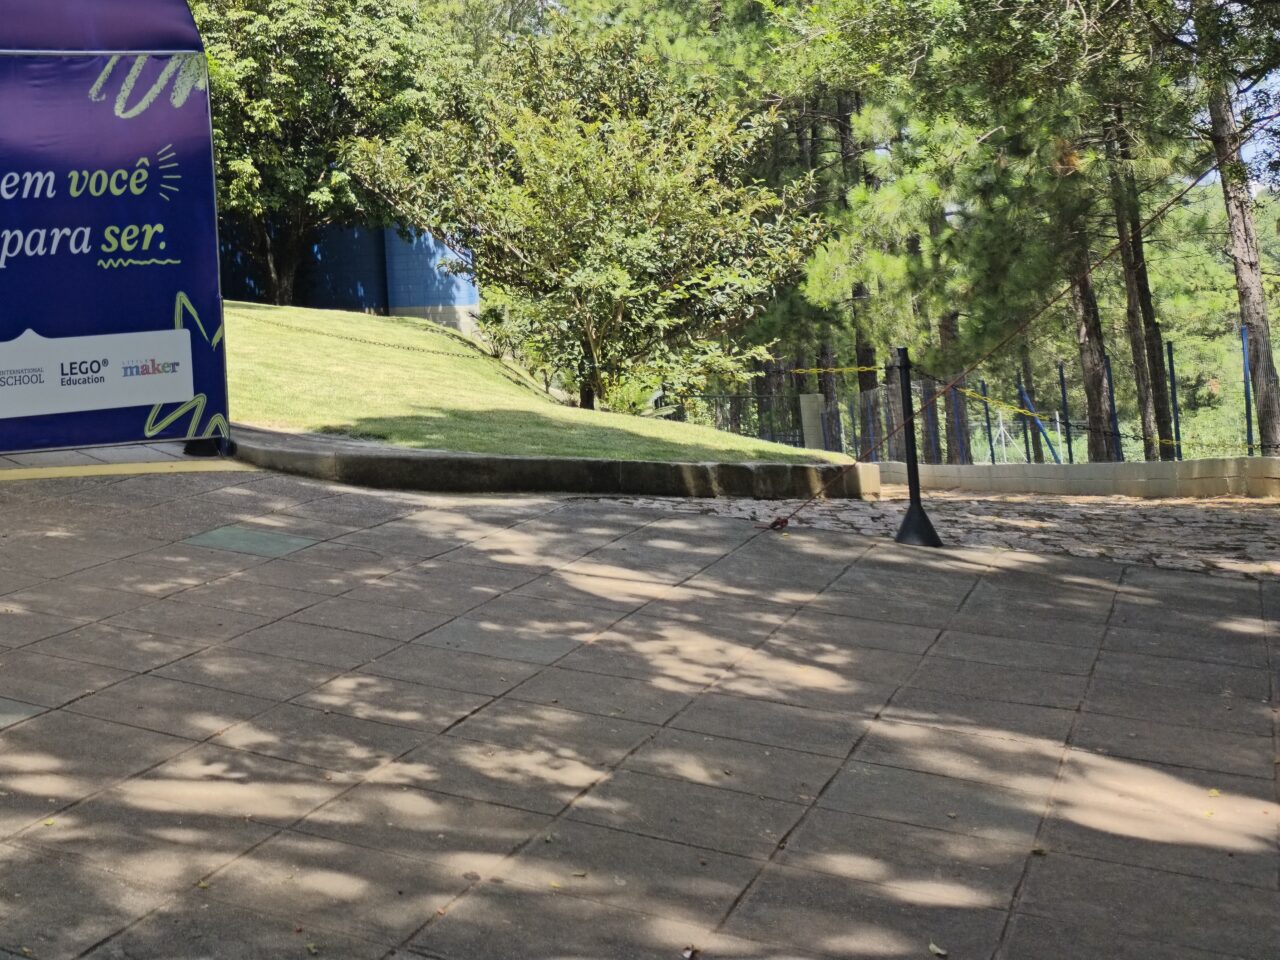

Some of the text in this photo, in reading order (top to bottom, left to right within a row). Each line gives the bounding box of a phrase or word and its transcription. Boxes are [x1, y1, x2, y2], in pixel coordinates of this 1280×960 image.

[68, 157, 151, 198] você
[100, 222, 167, 253] ser.
[0, 367, 44, 376] INTERNATIONAL
[121, 358, 180, 378] maker
[0, 374, 45, 387] SCHOOL
[60, 375, 105, 386] Education
